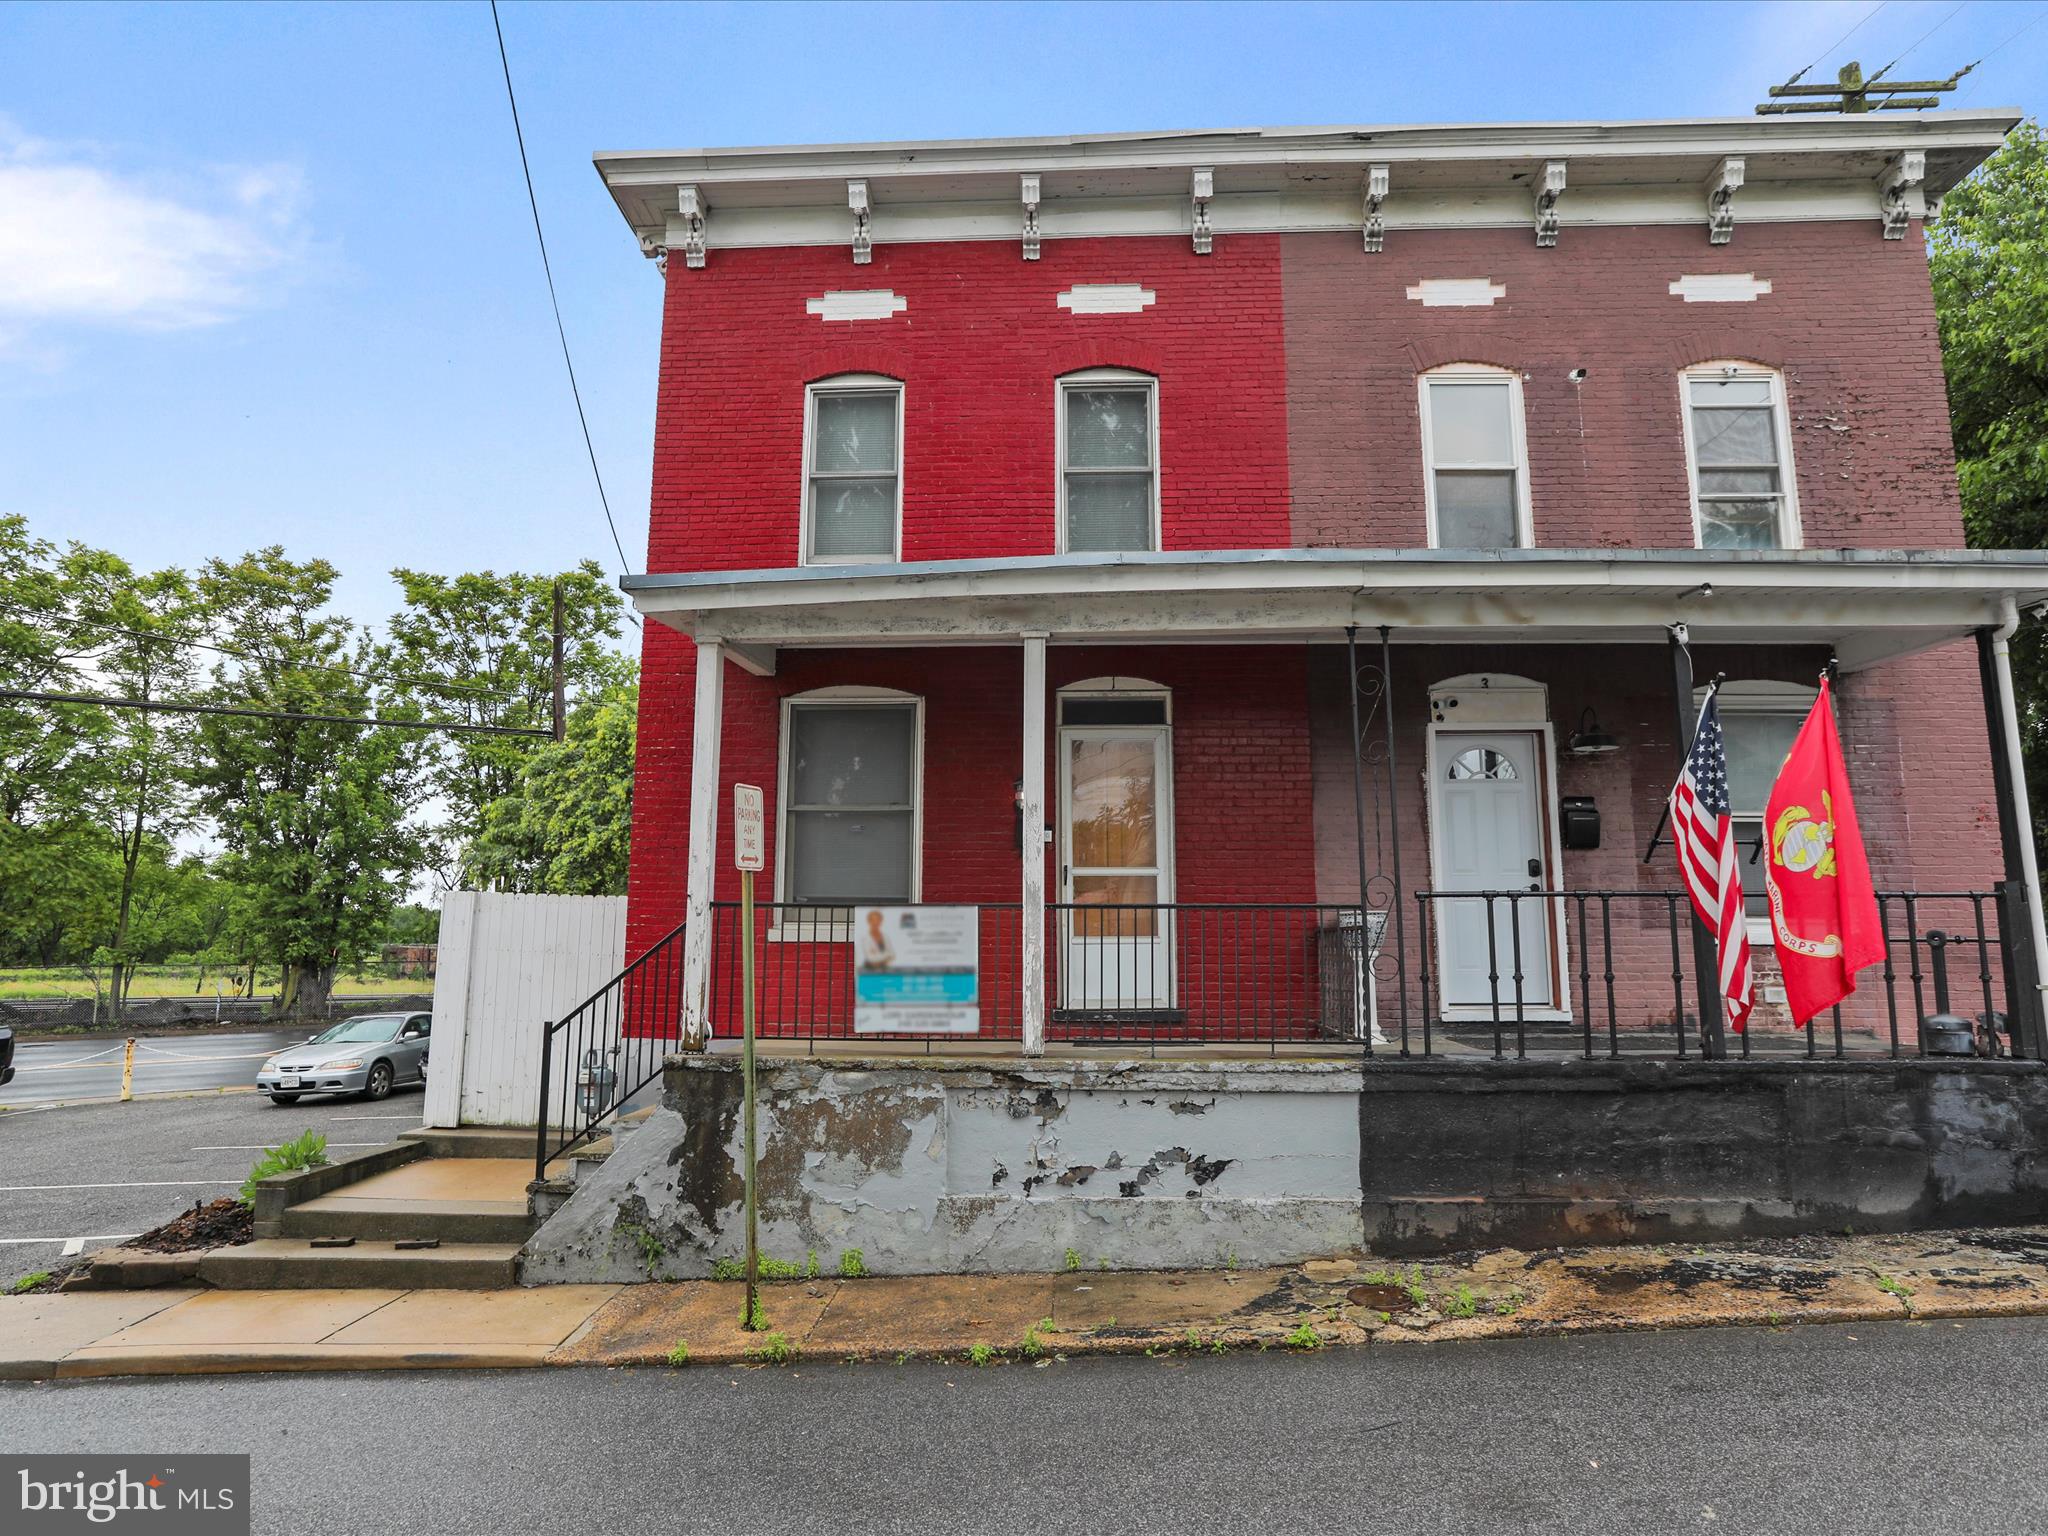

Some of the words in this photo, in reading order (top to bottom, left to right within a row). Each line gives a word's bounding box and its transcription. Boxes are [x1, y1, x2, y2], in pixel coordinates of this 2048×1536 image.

[1481, 677, 1489, 689] 3
[744, 792, 754, 807] NO
[737, 807, 760, 823] PARKING
[743, 825, 756, 836] ANY
[743, 838, 756, 850] TIME
[1767, 881, 1781, 916] MARINE
[1779, 926, 1817, 953] CORPS
